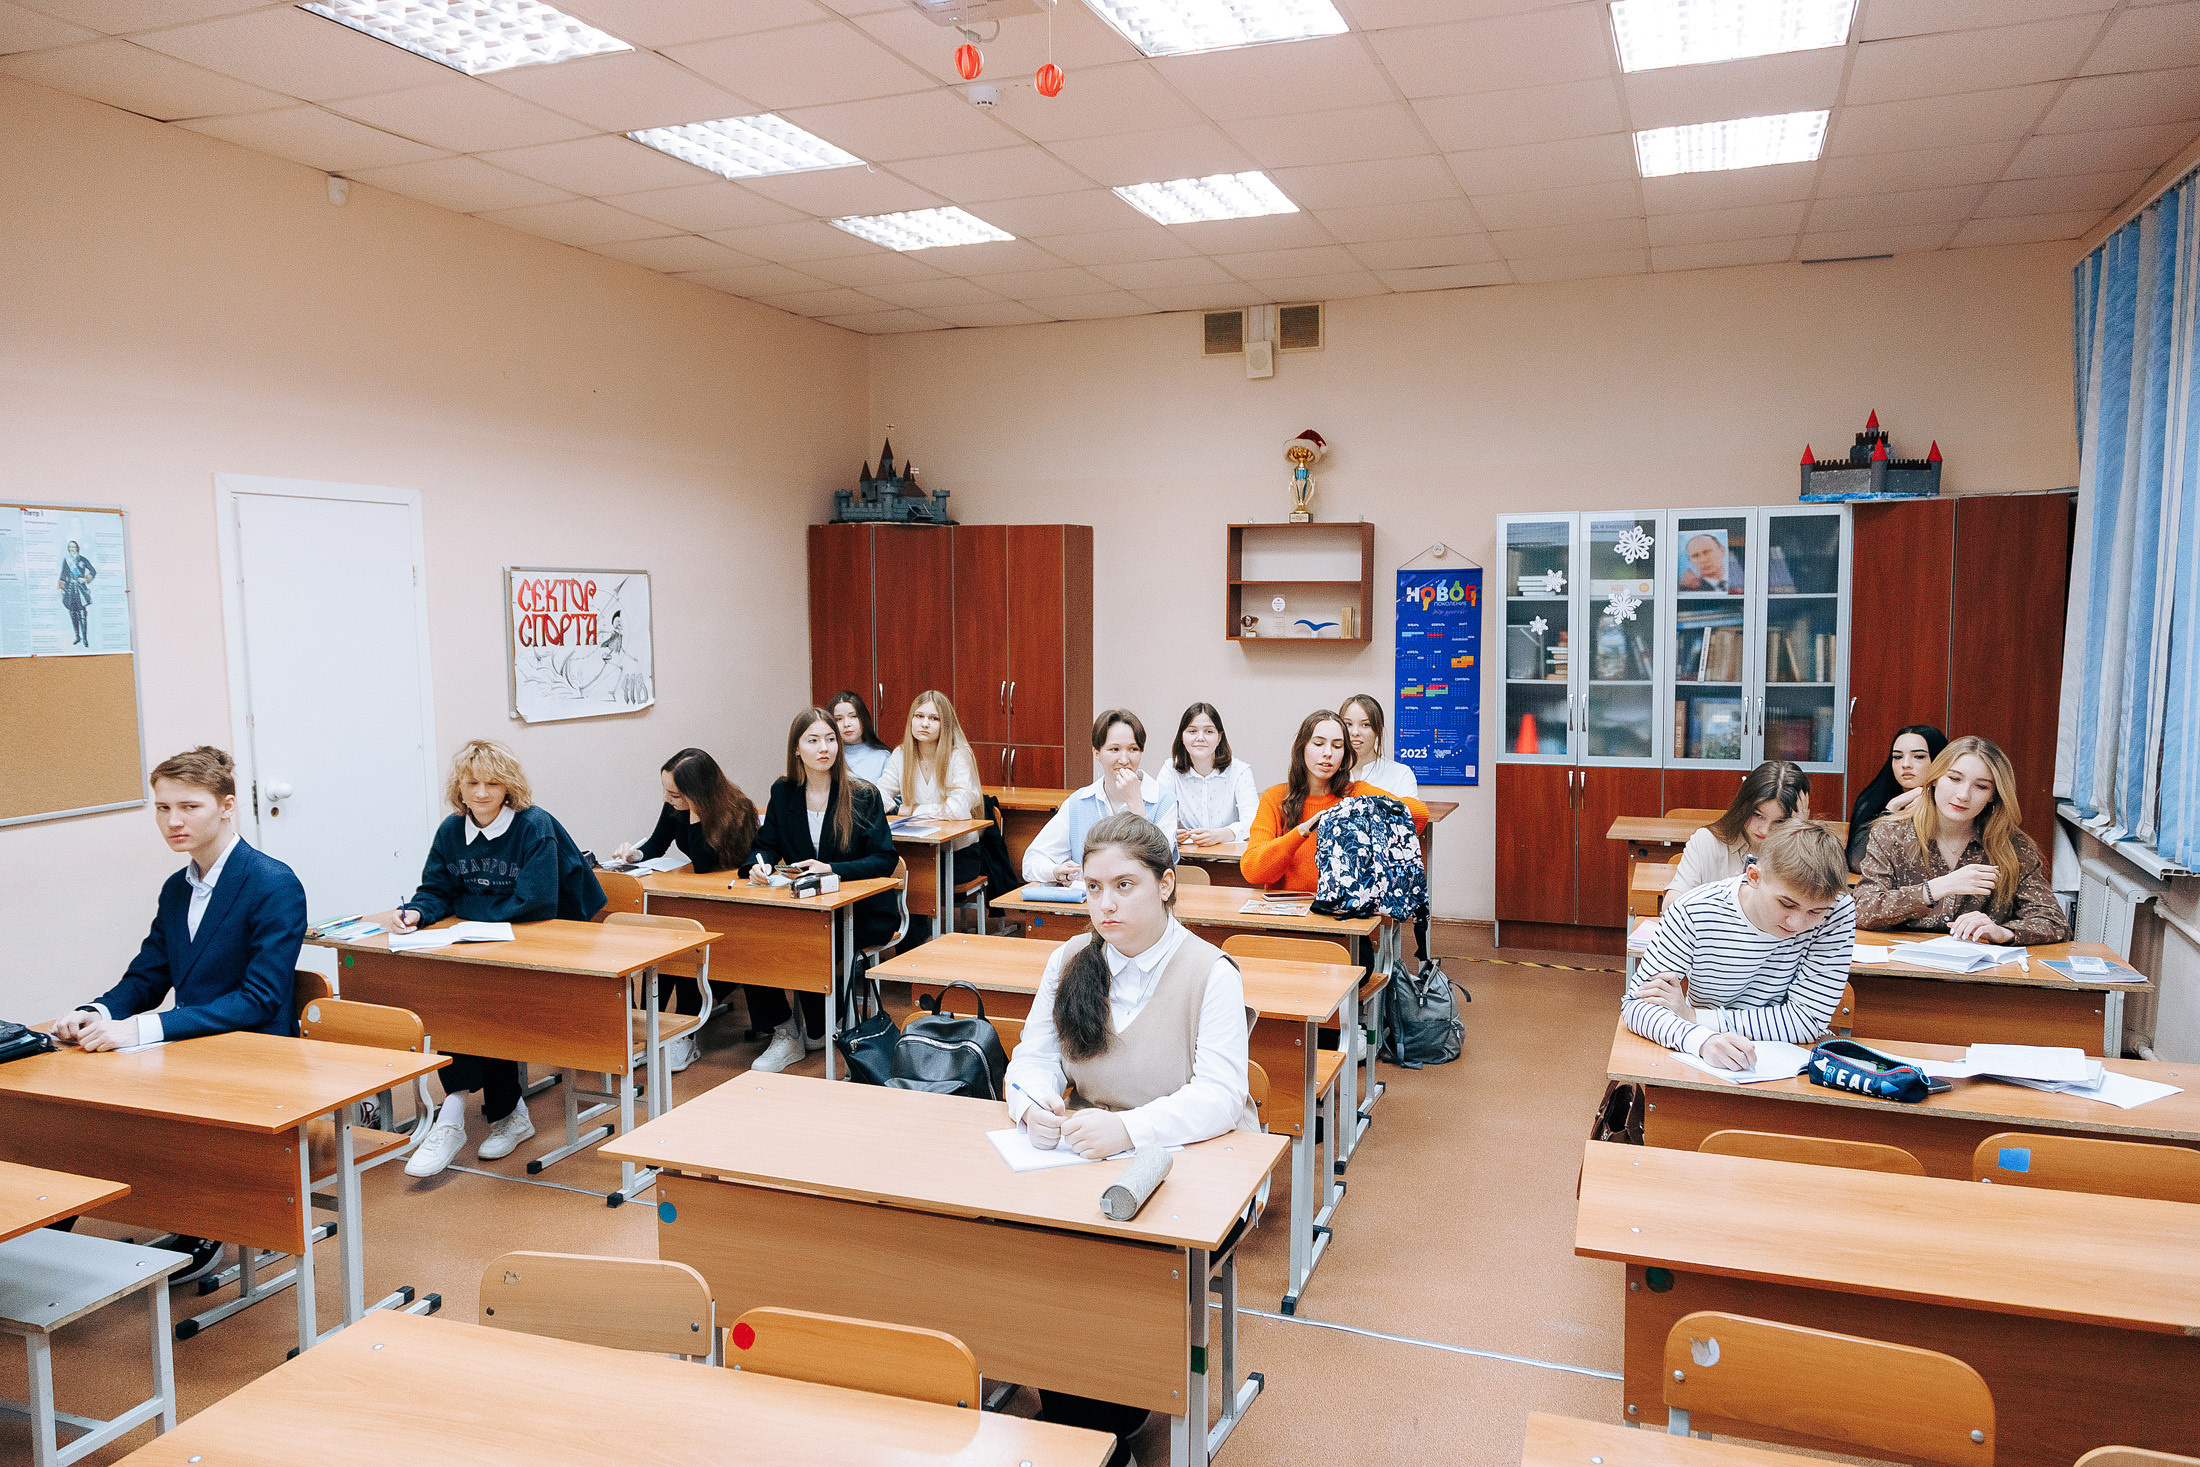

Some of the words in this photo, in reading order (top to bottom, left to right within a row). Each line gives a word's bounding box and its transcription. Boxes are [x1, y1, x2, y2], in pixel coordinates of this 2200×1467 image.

[518, 578, 596, 612] СЕКТОР
[1406, 582, 1477, 606] НОВОЕ
[518, 613, 598, 647] СПОРТА
[1400, 749, 1428, 758] 2023
[1823, 1066, 1873, 1094] REAL
